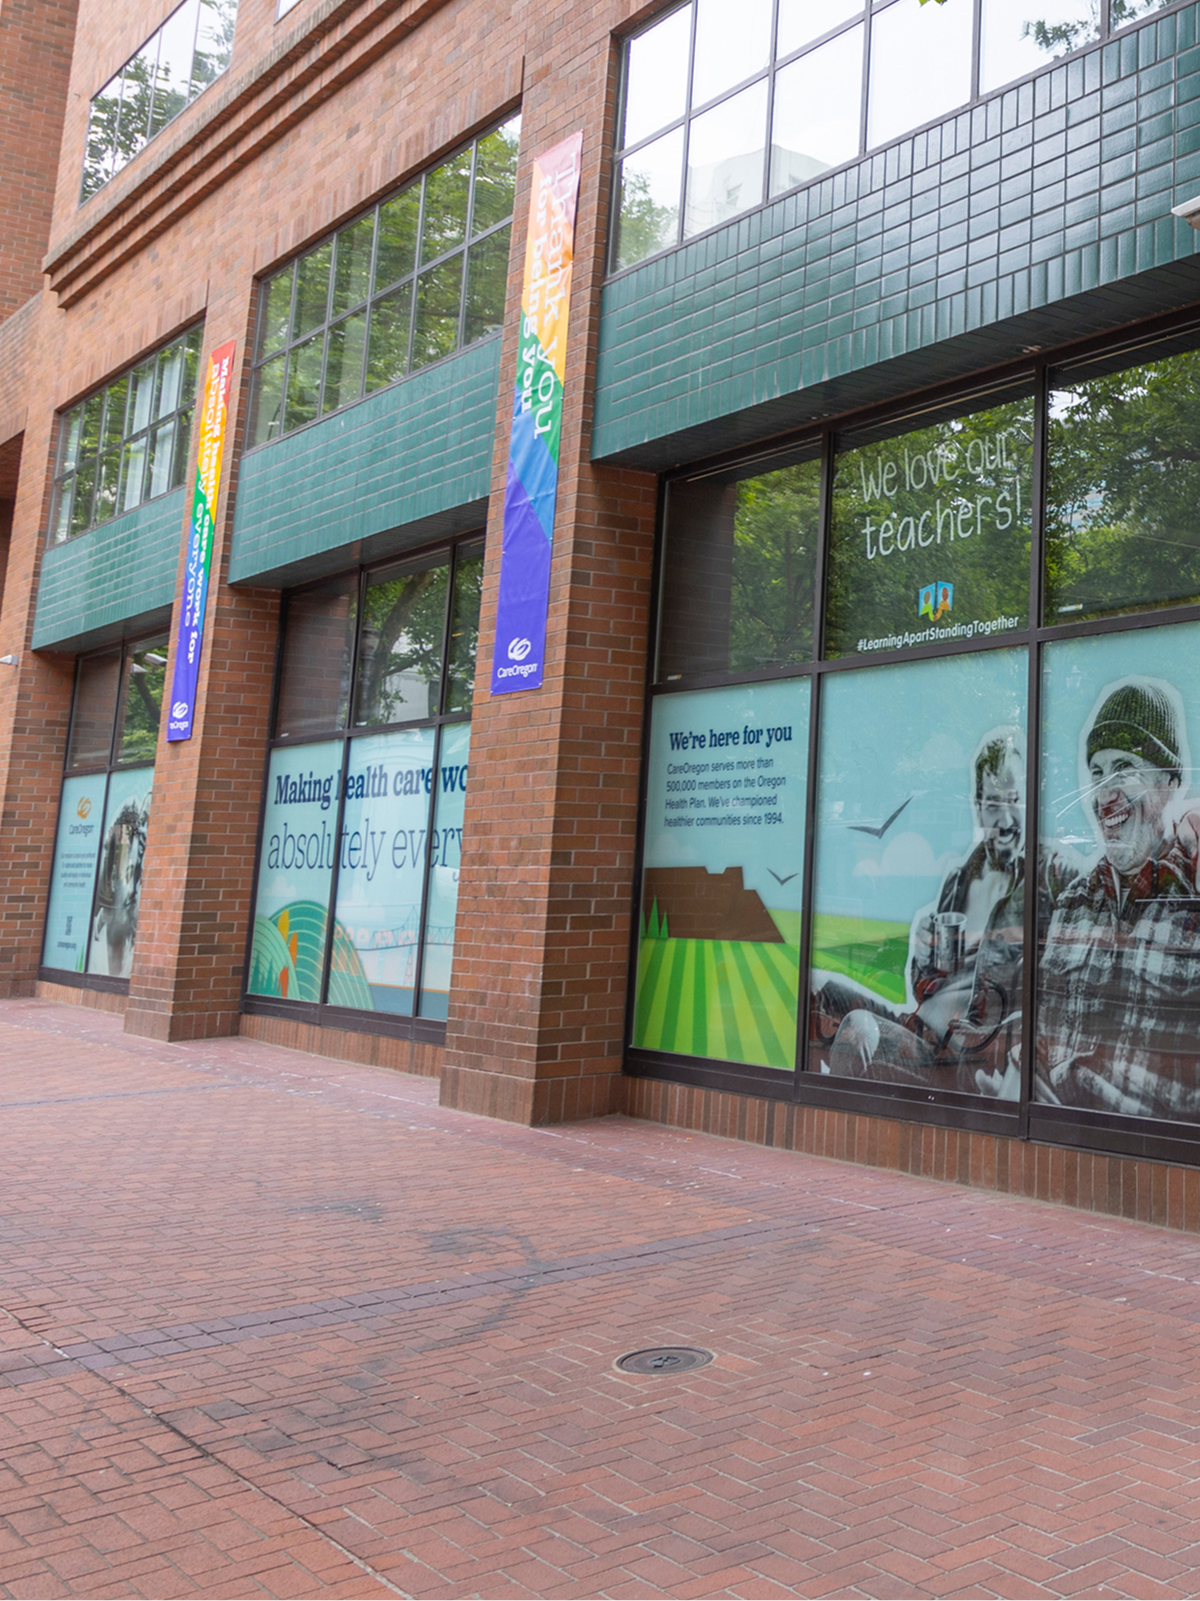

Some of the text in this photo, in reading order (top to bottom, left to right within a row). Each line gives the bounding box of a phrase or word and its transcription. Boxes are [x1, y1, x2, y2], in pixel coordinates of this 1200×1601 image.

[522, 174, 552, 414] for being you
[534, 151, 577, 440] Thank you
[212, 356, 229, 438] Making
[860, 427, 1018, 502] We love our
[184, 363, 220, 628] absolutely everyone
[861, 475, 1022, 560] teachers!
[199, 514, 210, 564] care
[192, 567, 204, 627] work
[187, 631, 198, 664] for
[857, 615, 1019, 652] #LearningApartStandingTogether
[497, 663, 538, 678] CareOregon
[669, 725, 793, 751] We're here for you
[274, 771, 333, 810] Making
[393, 767, 433, 796] care
[666, 775, 786, 793] 500,000 members on the Oregon
[667, 757, 774, 776] CareOregon serves more than
[664, 812, 784, 827] healthier communities since 1994.
[665, 794, 778, 810] Health Plan. We've championed
[268, 818, 386, 881] absolutely
